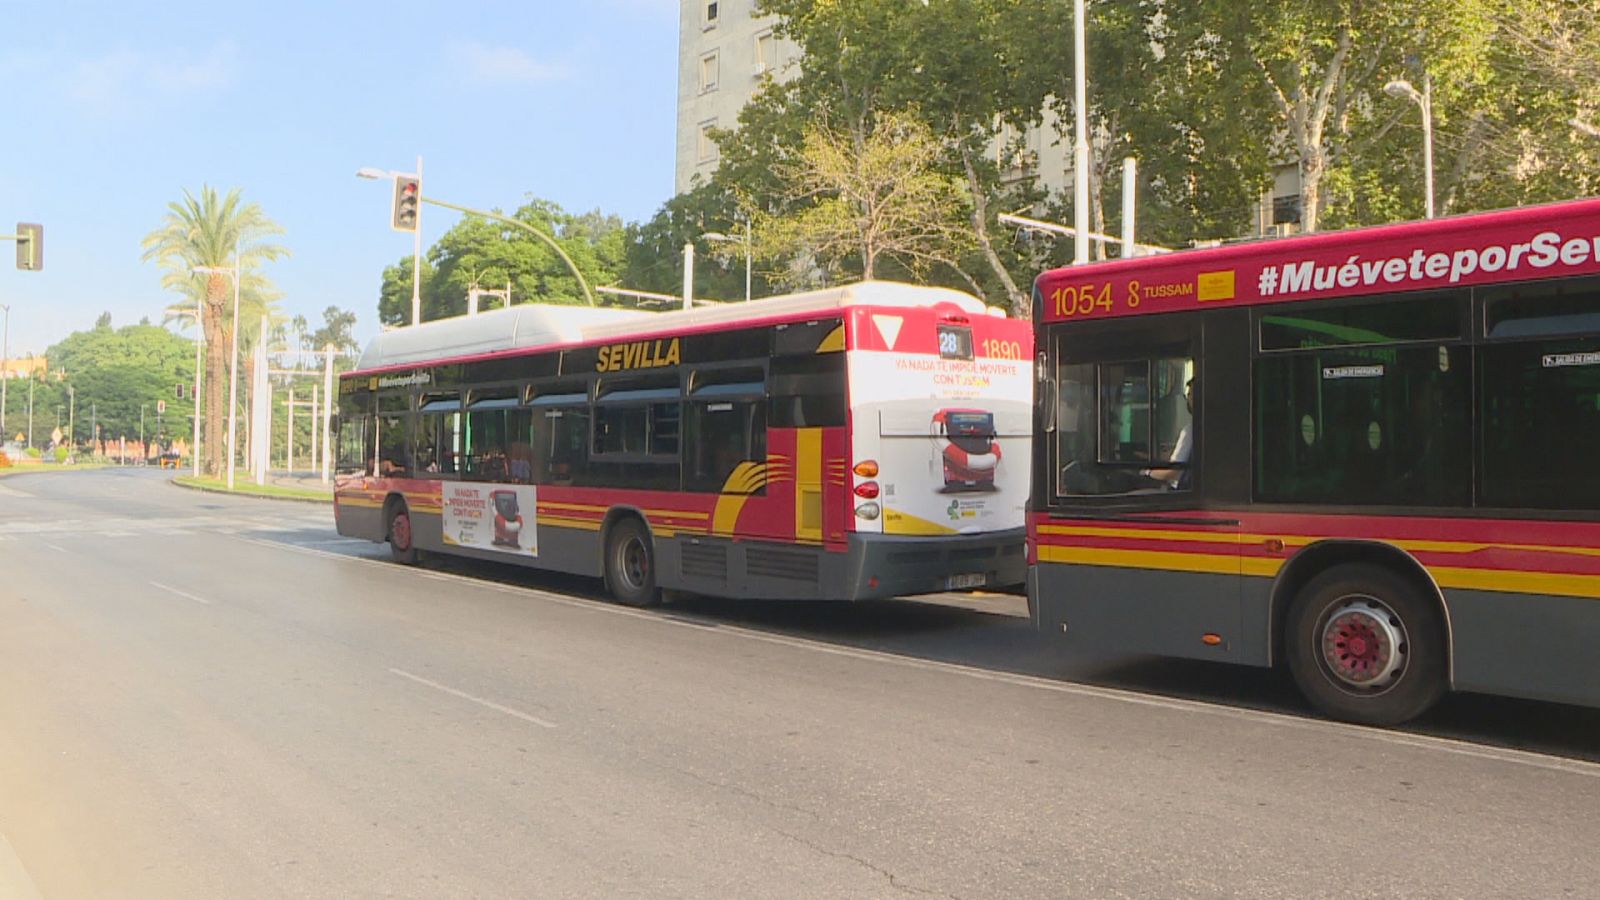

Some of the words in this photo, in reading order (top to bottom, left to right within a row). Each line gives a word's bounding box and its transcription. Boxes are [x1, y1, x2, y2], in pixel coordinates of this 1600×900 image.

[1050, 282, 1113, 316] 1054
[1143, 283, 1193, 298] TUSSAM
[939, 332, 957, 353] 28
[982, 338, 1021, 360] 1890
[596, 337, 681, 372] SEVILLA
[909, 360, 935, 371] NADA
[937, 361, 948, 372] TE
[980, 364, 1017, 376] MOVERTE
[933, 374, 953, 385] CON
